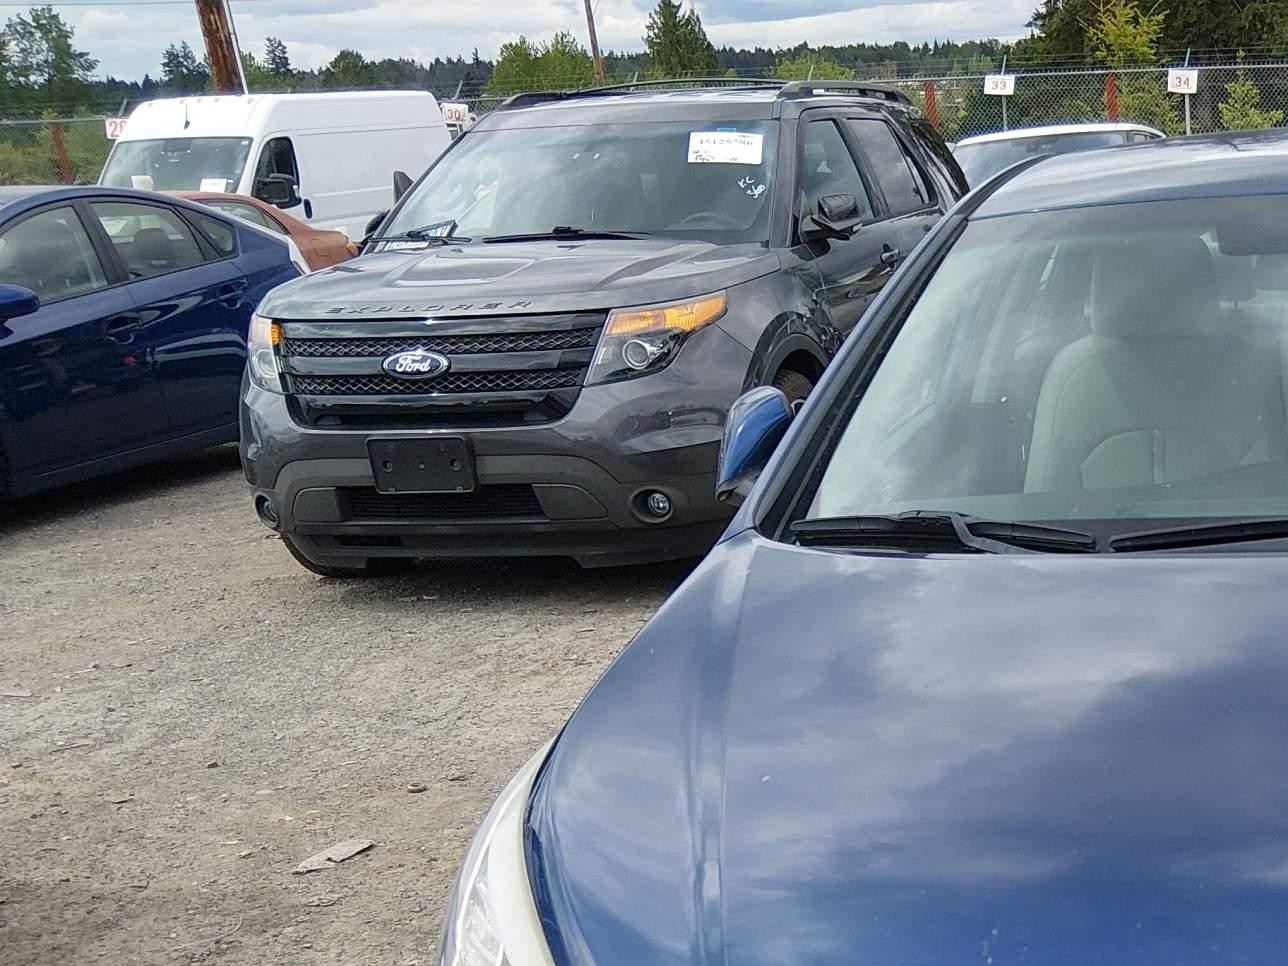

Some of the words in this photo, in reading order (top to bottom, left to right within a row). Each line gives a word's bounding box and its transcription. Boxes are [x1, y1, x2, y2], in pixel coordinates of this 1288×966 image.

[991, 80, 1007, 90] 33
[1175, 76, 1190, 88] 34
[447, 109, 461, 120] 30
[324, 300, 533, 314] EXPLORER
[395, 355, 432, 372] Ford
